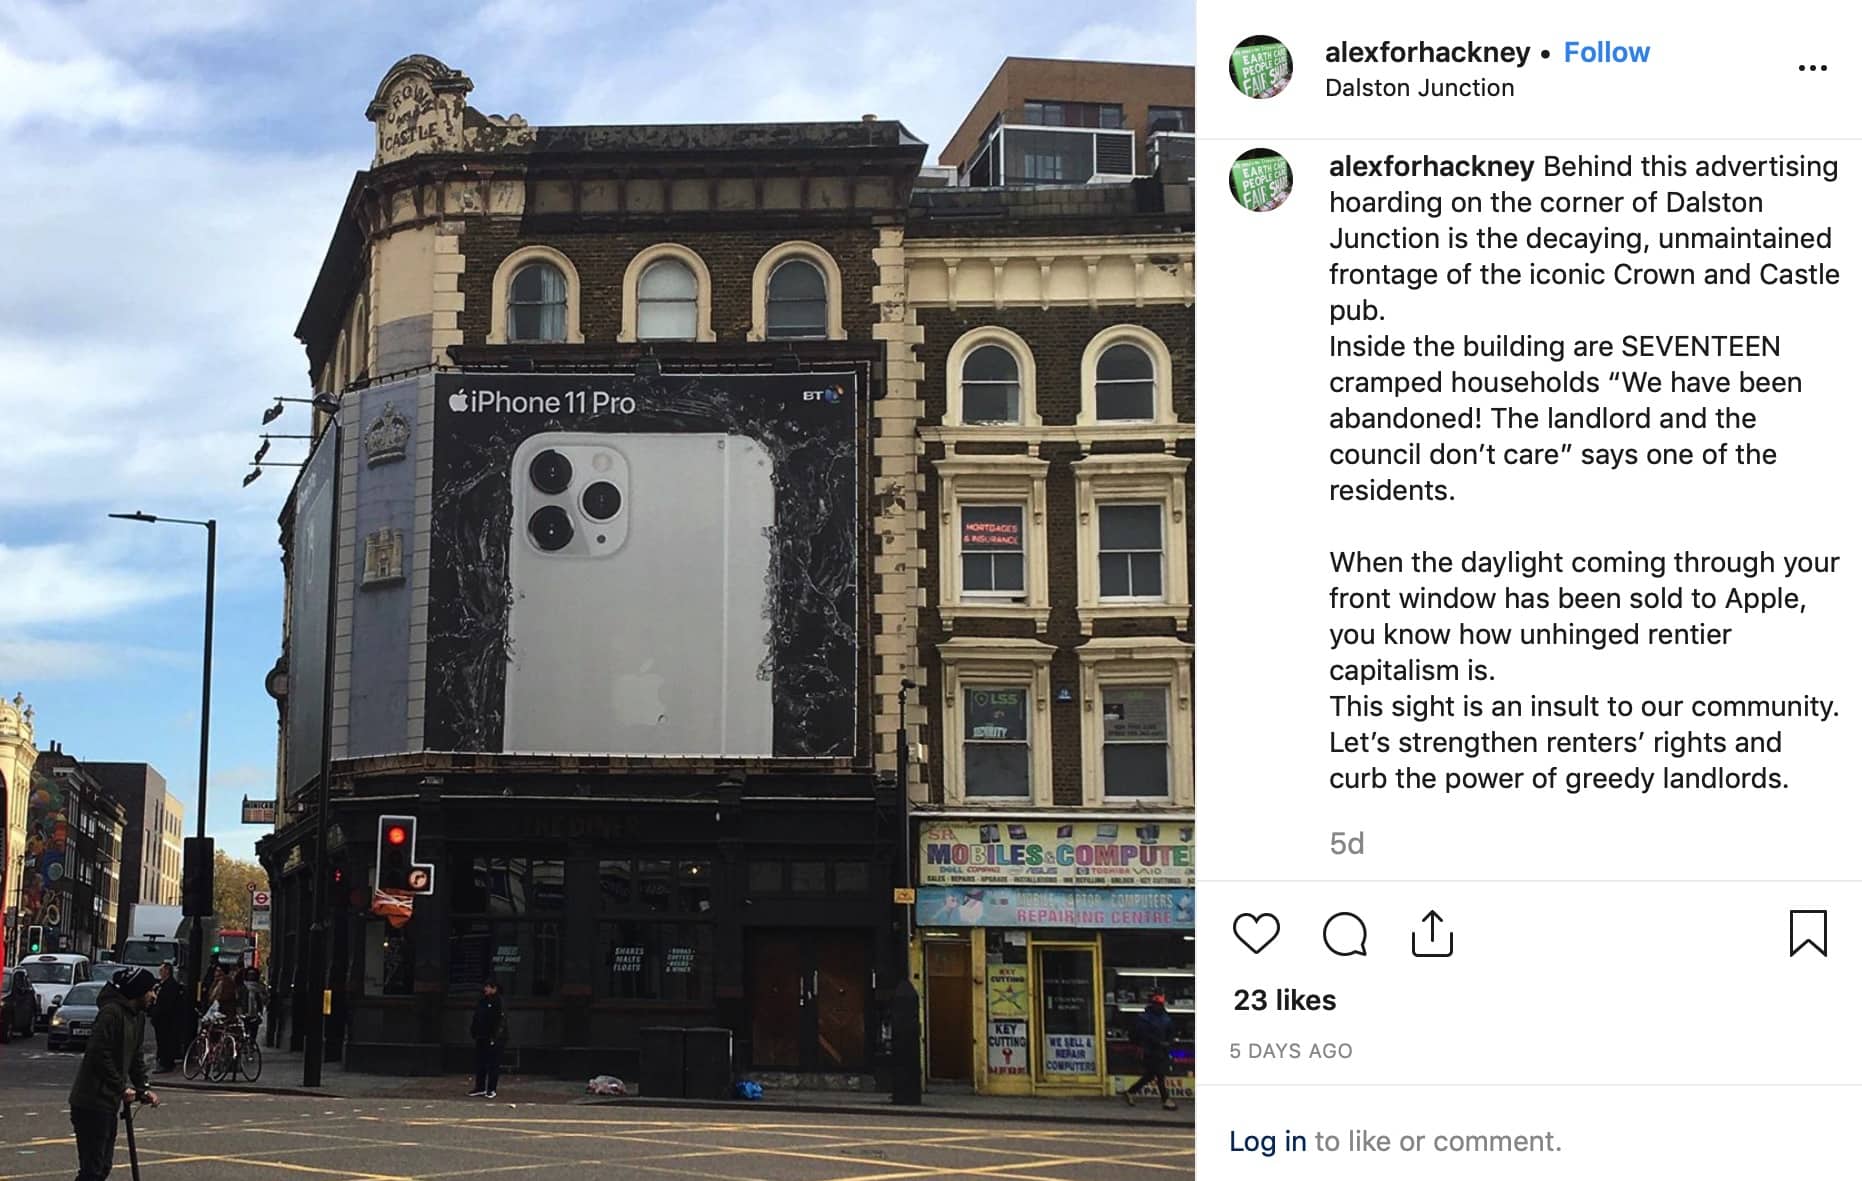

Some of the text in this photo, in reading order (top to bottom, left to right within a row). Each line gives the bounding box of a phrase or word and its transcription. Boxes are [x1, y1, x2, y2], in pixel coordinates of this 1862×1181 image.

[385, 122, 437, 152] CASTLE
[803, 391, 824, 400] BT
[471, 389, 636, 414] iPhone 11 Pro
[971, 535, 1018, 544] INSURANCE
[927, 843, 1043, 866] MOBILES
[1016, 909, 1171, 924] REPAIRING CENTRE
[995, 1024, 1017, 1034] KEY
[989, 1036, 1026, 1047] CUTTING
[1049, 1037, 1062, 1048] WE
[1064, 1037, 1084, 1047] SELL
[1056, 1049, 1086, 1059] REPAIR
[1047, 1060, 1094, 1071] COMPUTERS
